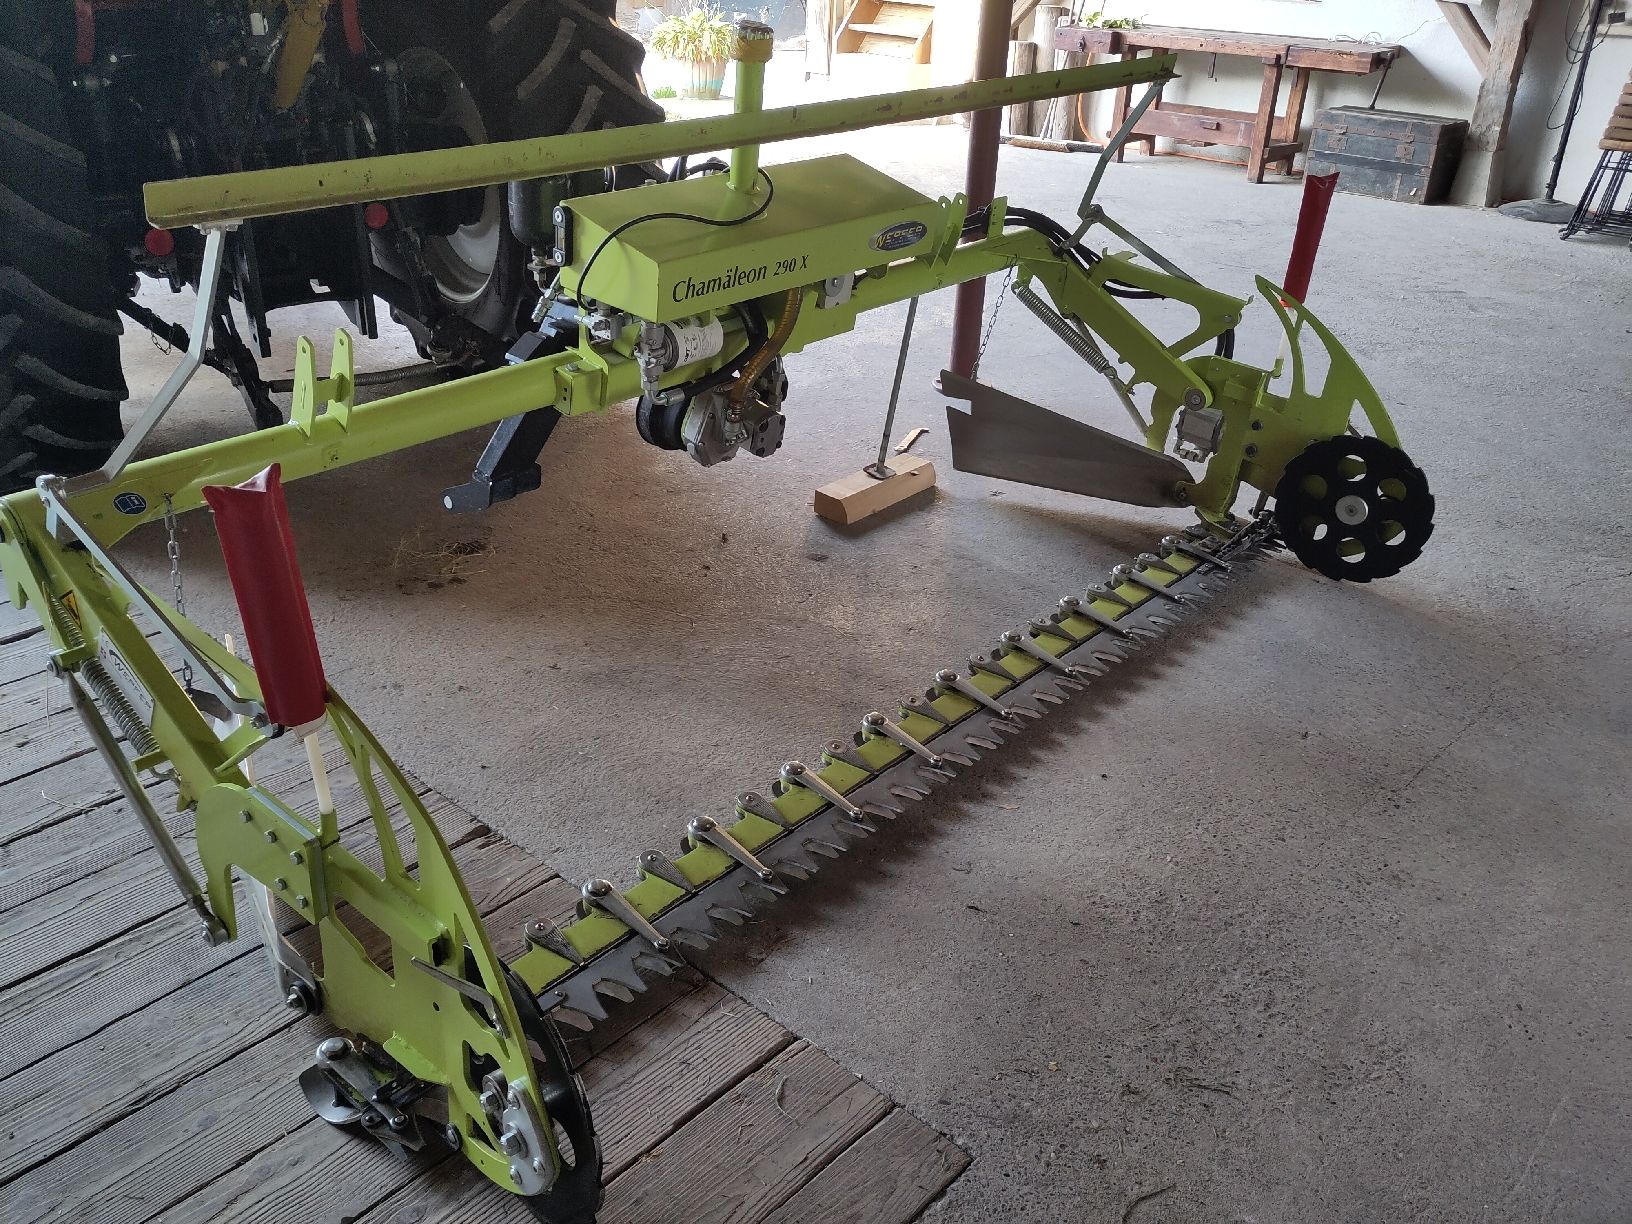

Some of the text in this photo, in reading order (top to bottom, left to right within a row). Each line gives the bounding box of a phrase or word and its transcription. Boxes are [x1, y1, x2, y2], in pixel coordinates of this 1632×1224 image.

[672, 254, 809, 303] Chamäleon 290 X
